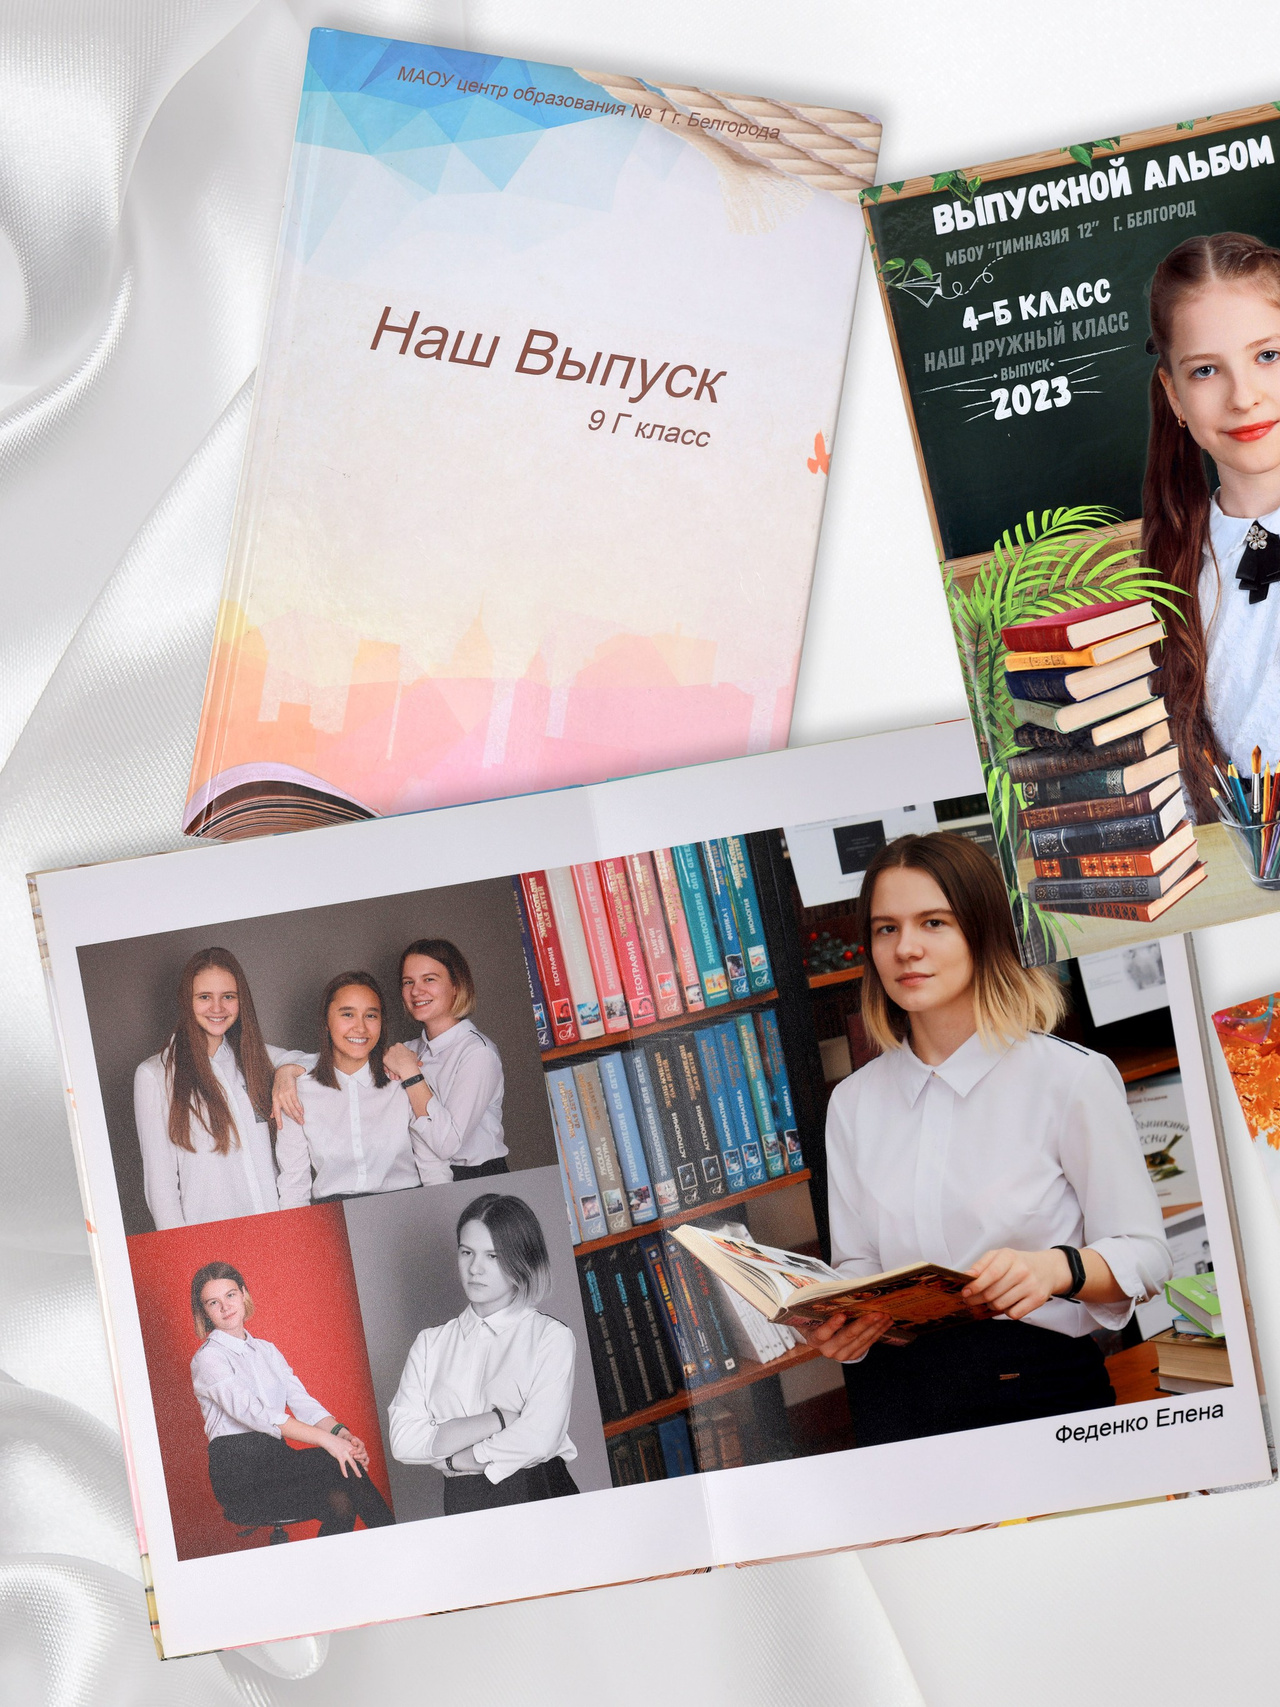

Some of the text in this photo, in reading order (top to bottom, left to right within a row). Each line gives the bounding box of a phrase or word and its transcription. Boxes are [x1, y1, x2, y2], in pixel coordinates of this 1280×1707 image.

[397, 66, 782, 141] МАОУ центр образования № 1 г. Белгорода
[933, 134, 1275, 236] ВЫПУСКНОЙ АЛЬБОМ
[945, 200, 1197, 268] МБОУ "ГИМНАЗИЯ 12" Г. БЕЛГОРОД
[1018, 278, 1112, 321] КЛАСС
[370, 306, 728, 404] Наш Выпуск
[923, 310, 1130, 373] НАШ ДРУЖНЫЙ КЛАСС
[1000, 358, 1051, 381] ВЫПУСК
[990, 375, 1072, 421] 2023
[588, 409, 712, 448] 9 Г класс
[743, 898, 755, 933] БИОЛОГИЯ
[547, 946, 560, 985] ГЕОГРАФИЯ
[625, 941, 644, 995] ГЕОГРАФИЯ
[681, 945, 694, 981] БИЗНЕС
[605, 1062, 617, 1089] ДЕТЕЙ
[618, 1113, 638, 1182] ЭНЦИКЛОПЕДИЯ
[672, 1112, 685, 1157] АСТРОНОМИЯ
[696, 1105, 710, 1150] АСТРОНОМИЯ
[1055, 1403, 1224, 1444] Феденко Елена
